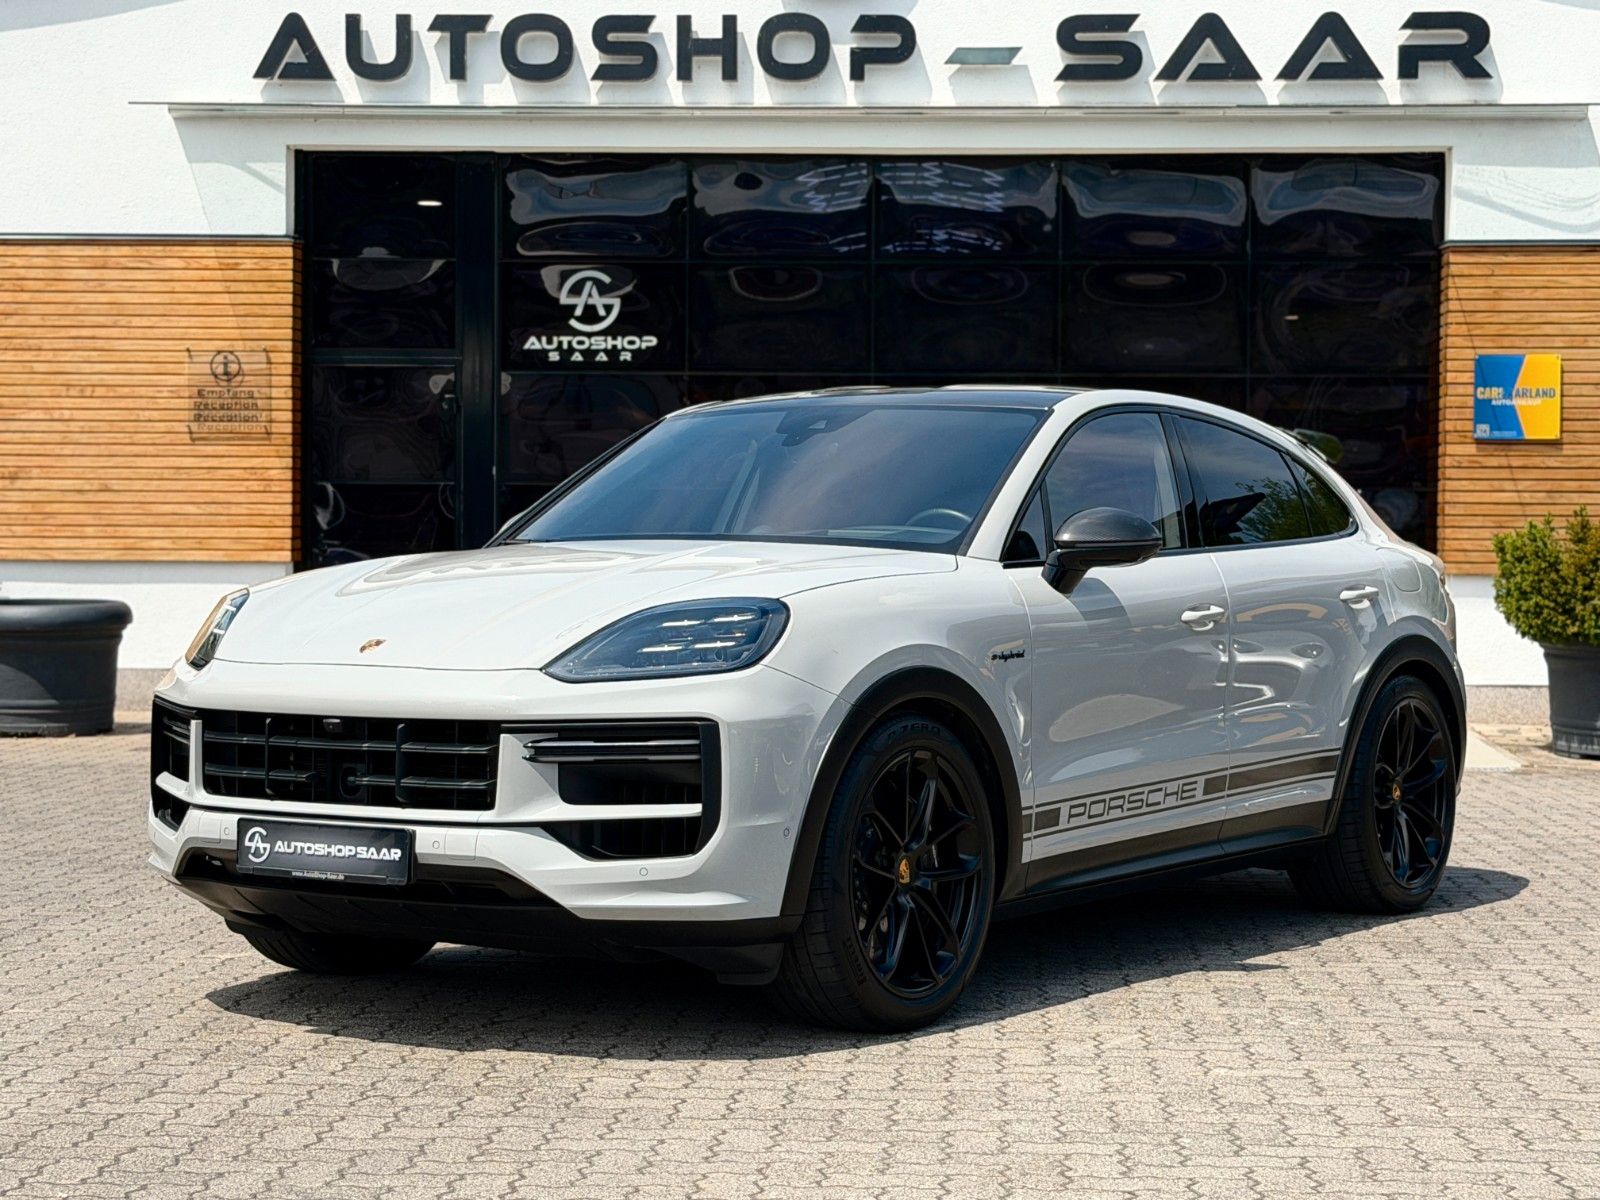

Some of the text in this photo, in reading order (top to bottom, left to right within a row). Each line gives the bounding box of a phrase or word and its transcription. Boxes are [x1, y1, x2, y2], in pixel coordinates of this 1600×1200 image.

[252, 11, 917, 82] AUTOSHOP
[1053, 11, 1493, 82] SAAR
[522, 335, 659, 350] AUTOSHOP
[547, 351, 632, 361] SAAR
[1067, 780, 1199, 824] PORSCHE
